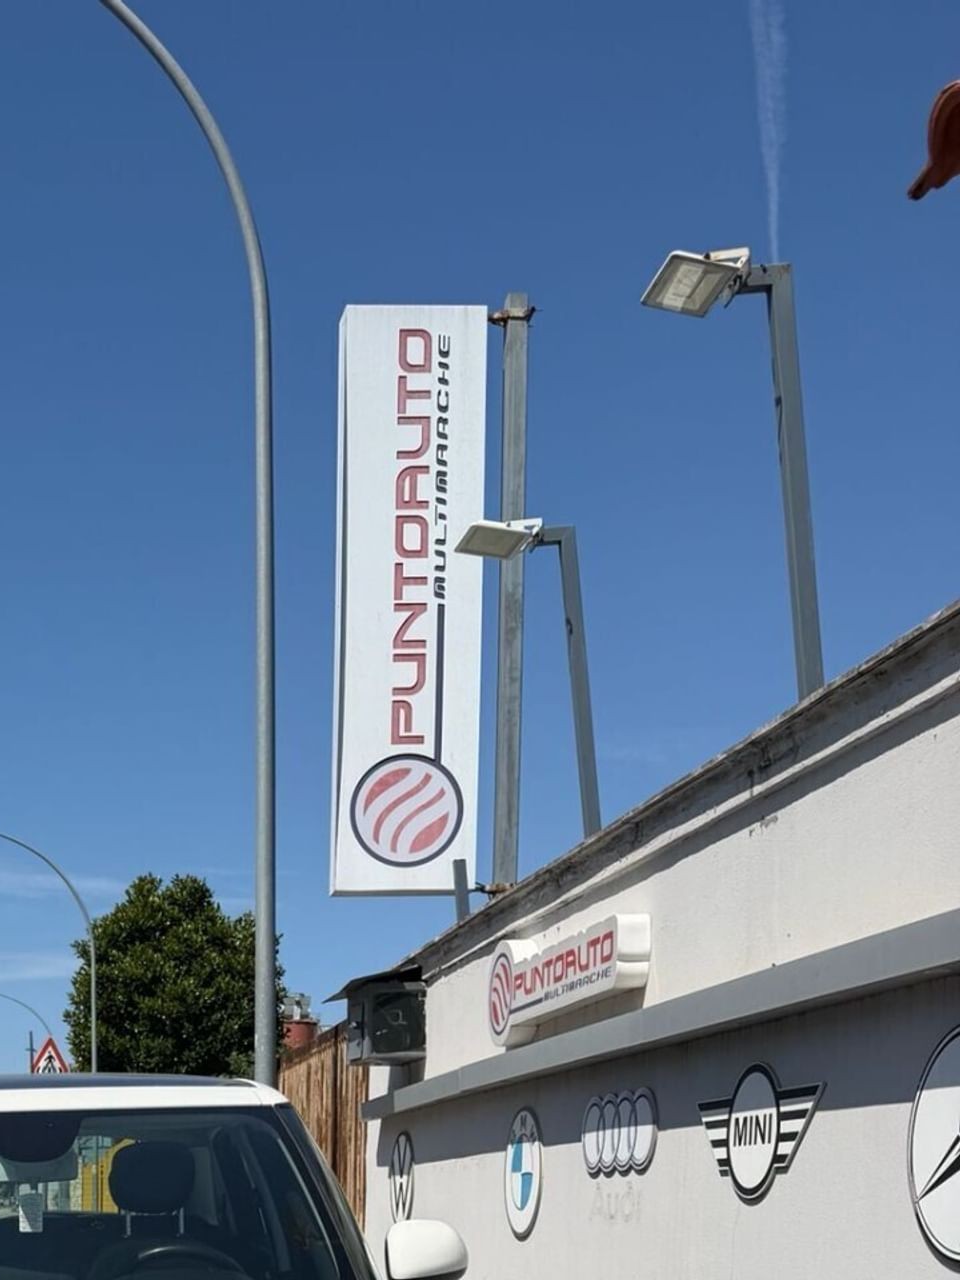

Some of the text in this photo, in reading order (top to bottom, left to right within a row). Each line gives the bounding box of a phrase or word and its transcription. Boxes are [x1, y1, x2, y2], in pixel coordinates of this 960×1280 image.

[433, 333, 451, 600] MULTIMARCHE
[390, 328, 433, 746] PUNTOAUTO
[513, 930, 614, 1001] PUNTOAUTO
[543, 965, 613, 1001] MULTIMARCHE
[733, 1113, 772, 1147] MINI
